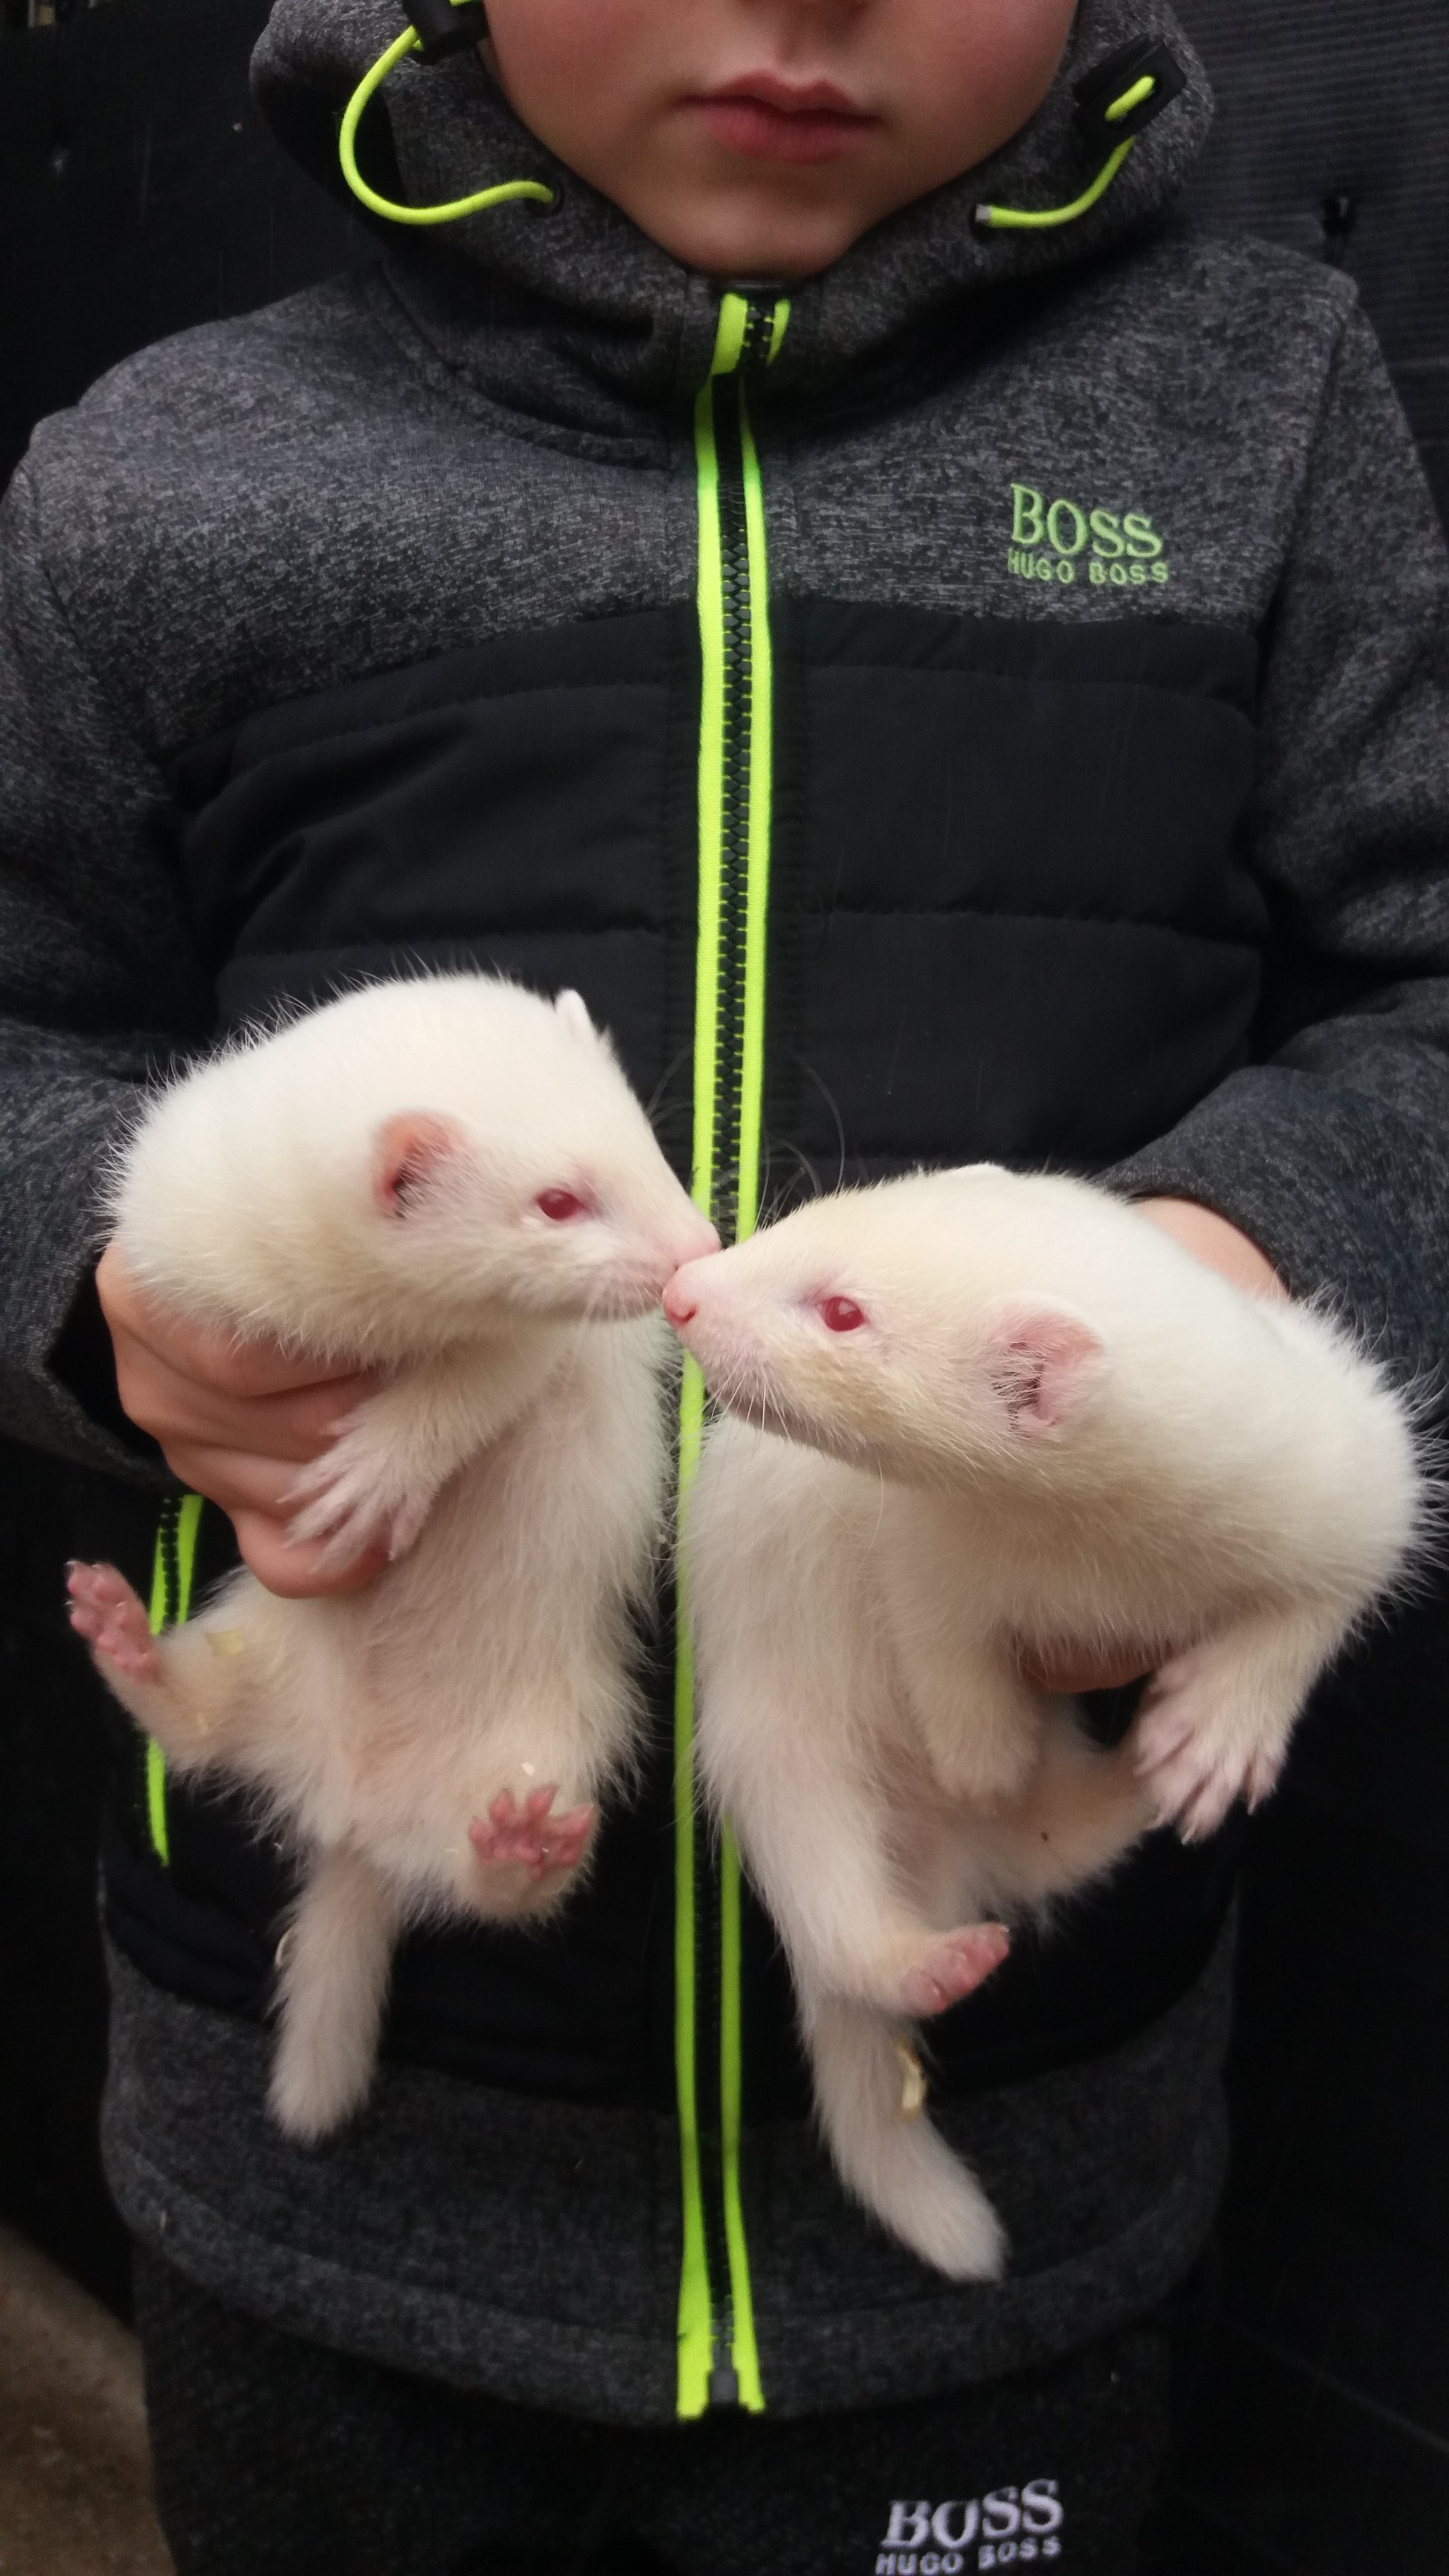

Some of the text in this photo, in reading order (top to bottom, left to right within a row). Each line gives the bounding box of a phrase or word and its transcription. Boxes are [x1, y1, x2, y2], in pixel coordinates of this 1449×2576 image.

[1010, 482, 1163, 559] BOSS
[1007, 547, 1169, 585] HUGO BOSS
[879, 2477, 1064, 2550] BOSS
[874, 2535, 1062, 2576] HUGO BOSS
